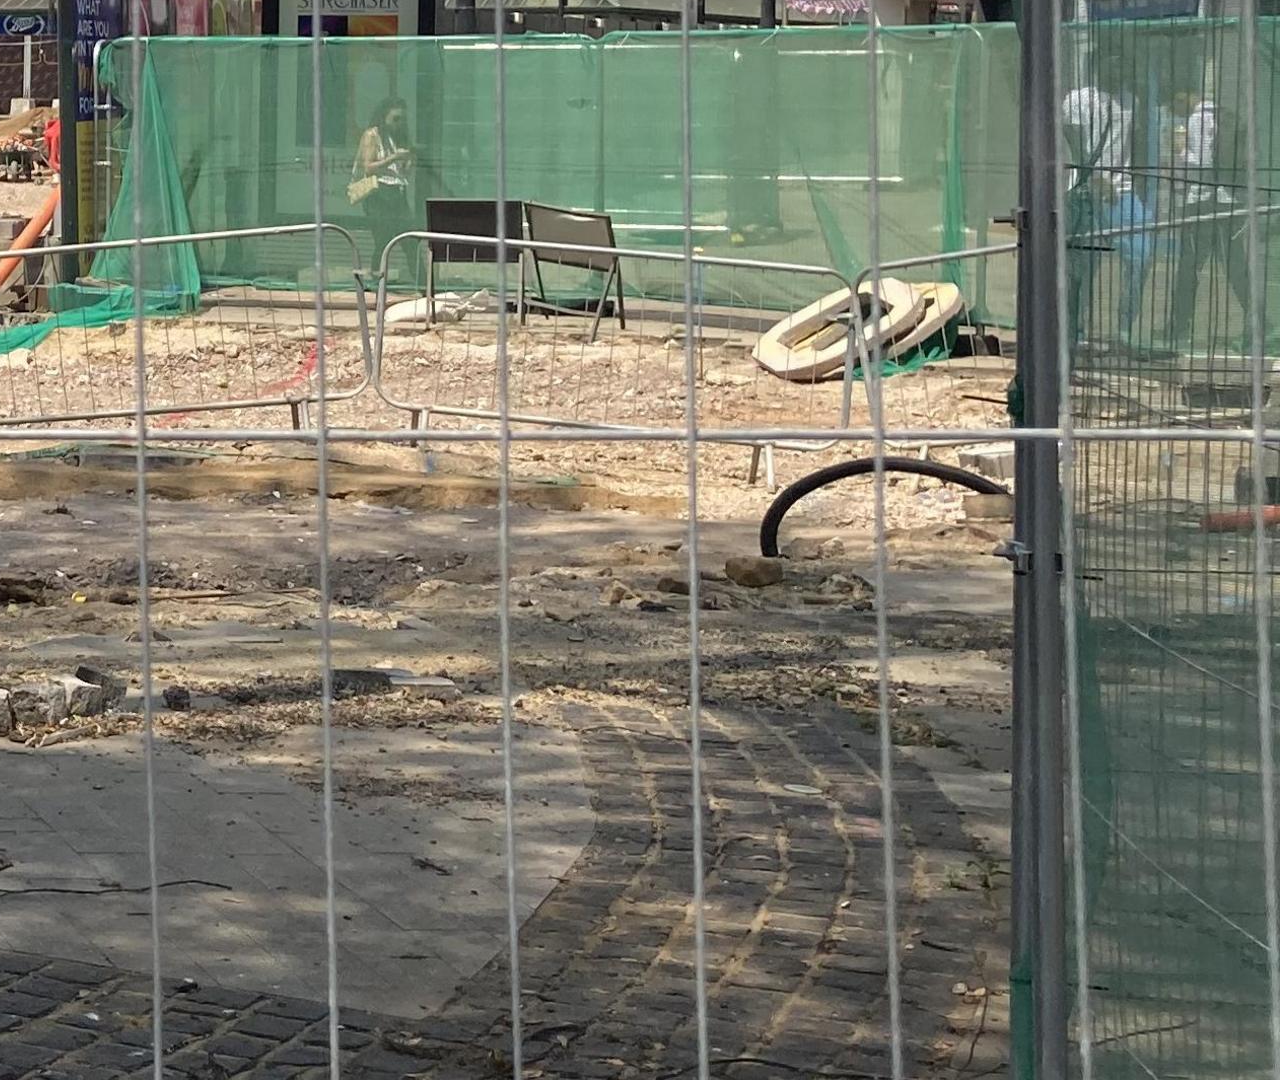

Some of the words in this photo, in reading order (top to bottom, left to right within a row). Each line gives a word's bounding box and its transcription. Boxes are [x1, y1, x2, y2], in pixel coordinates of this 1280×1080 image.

[77, 0, 101, 15] WHAT
[77, 22, 93, 36] ARE
[94, 21, 110, 38] YOU
